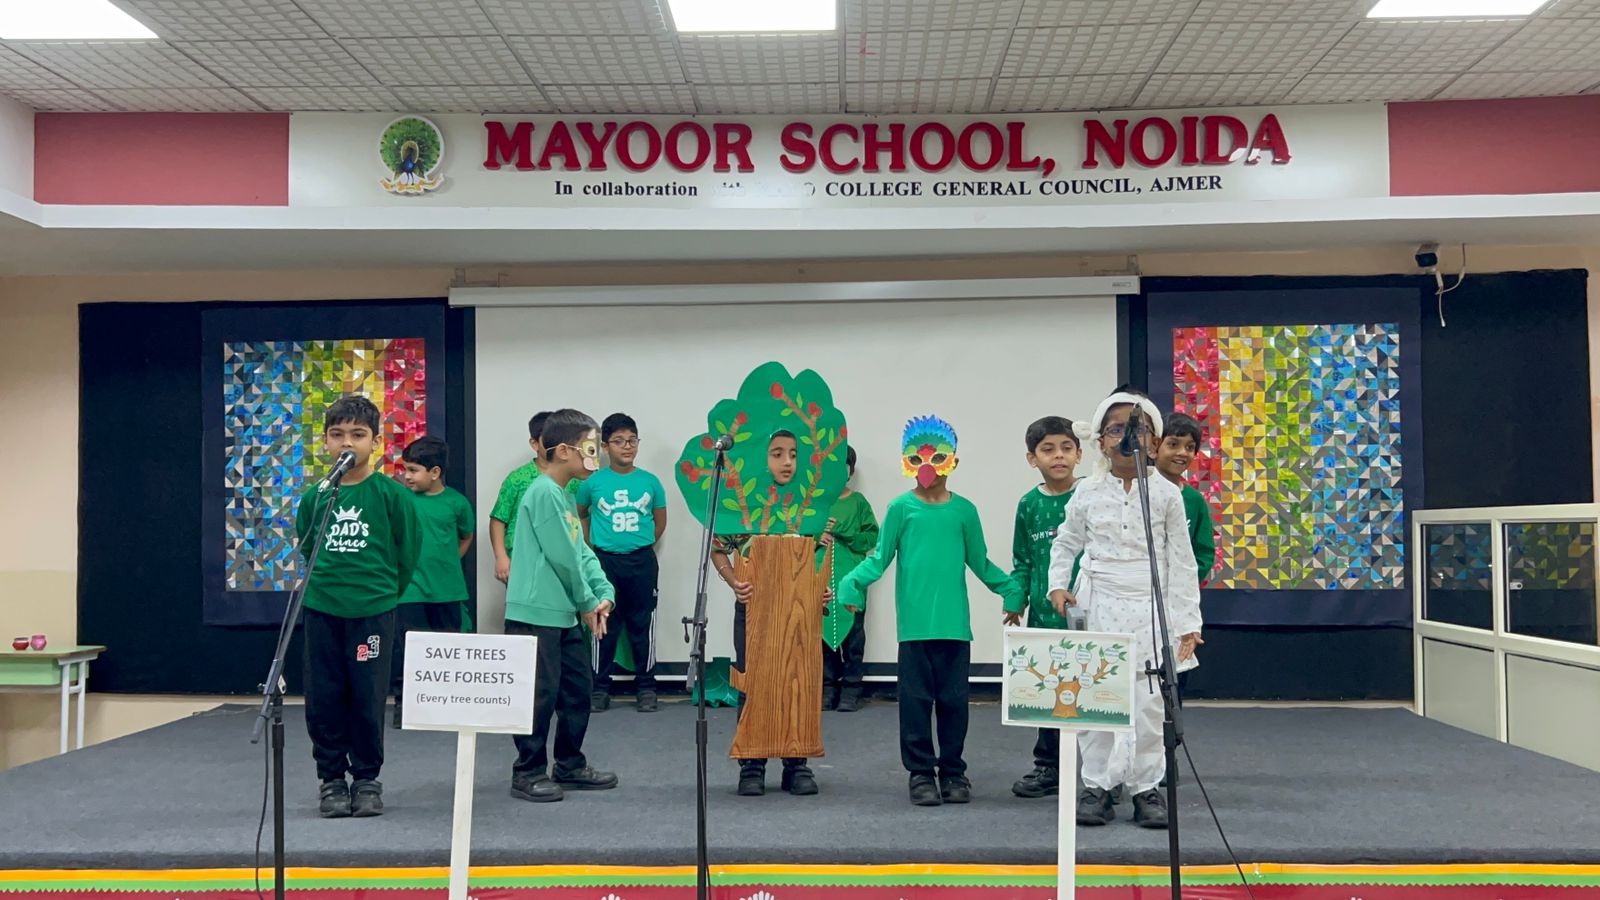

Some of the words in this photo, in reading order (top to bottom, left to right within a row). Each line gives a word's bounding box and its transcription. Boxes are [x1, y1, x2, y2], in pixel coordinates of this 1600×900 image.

[483, 121, 754, 172] MAYOOR
[780, 121, 1056, 178] SCHOOL,
[1082, 114, 1292, 167] NOIDA
[555, 181, 573, 196] In
[583, 181, 698, 197] collaboration
[825, 181, 923, 198] COLLEGE
[933, 180, 1032, 197] GENERAL
[1039, 178, 1142, 196] COUNCIL,
[1150, 175, 1223, 192] AJMER
[330, 520, 369, 537] DAD'S
[612, 512, 638, 532] 92
[325, 533, 368, 551] Prince
[356, 635, 380, 661] 23
[425, 647, 460, 659] SAVE
[465, 649, 506, 660] TREES
[415, 670, 451, 683] SAVE
[455, 672, 514, 684] FORESTS
[416, 693, 448, 705] (Every
[450, 695, 471, 704] tree
[474, 695, 511, 706] counts)
